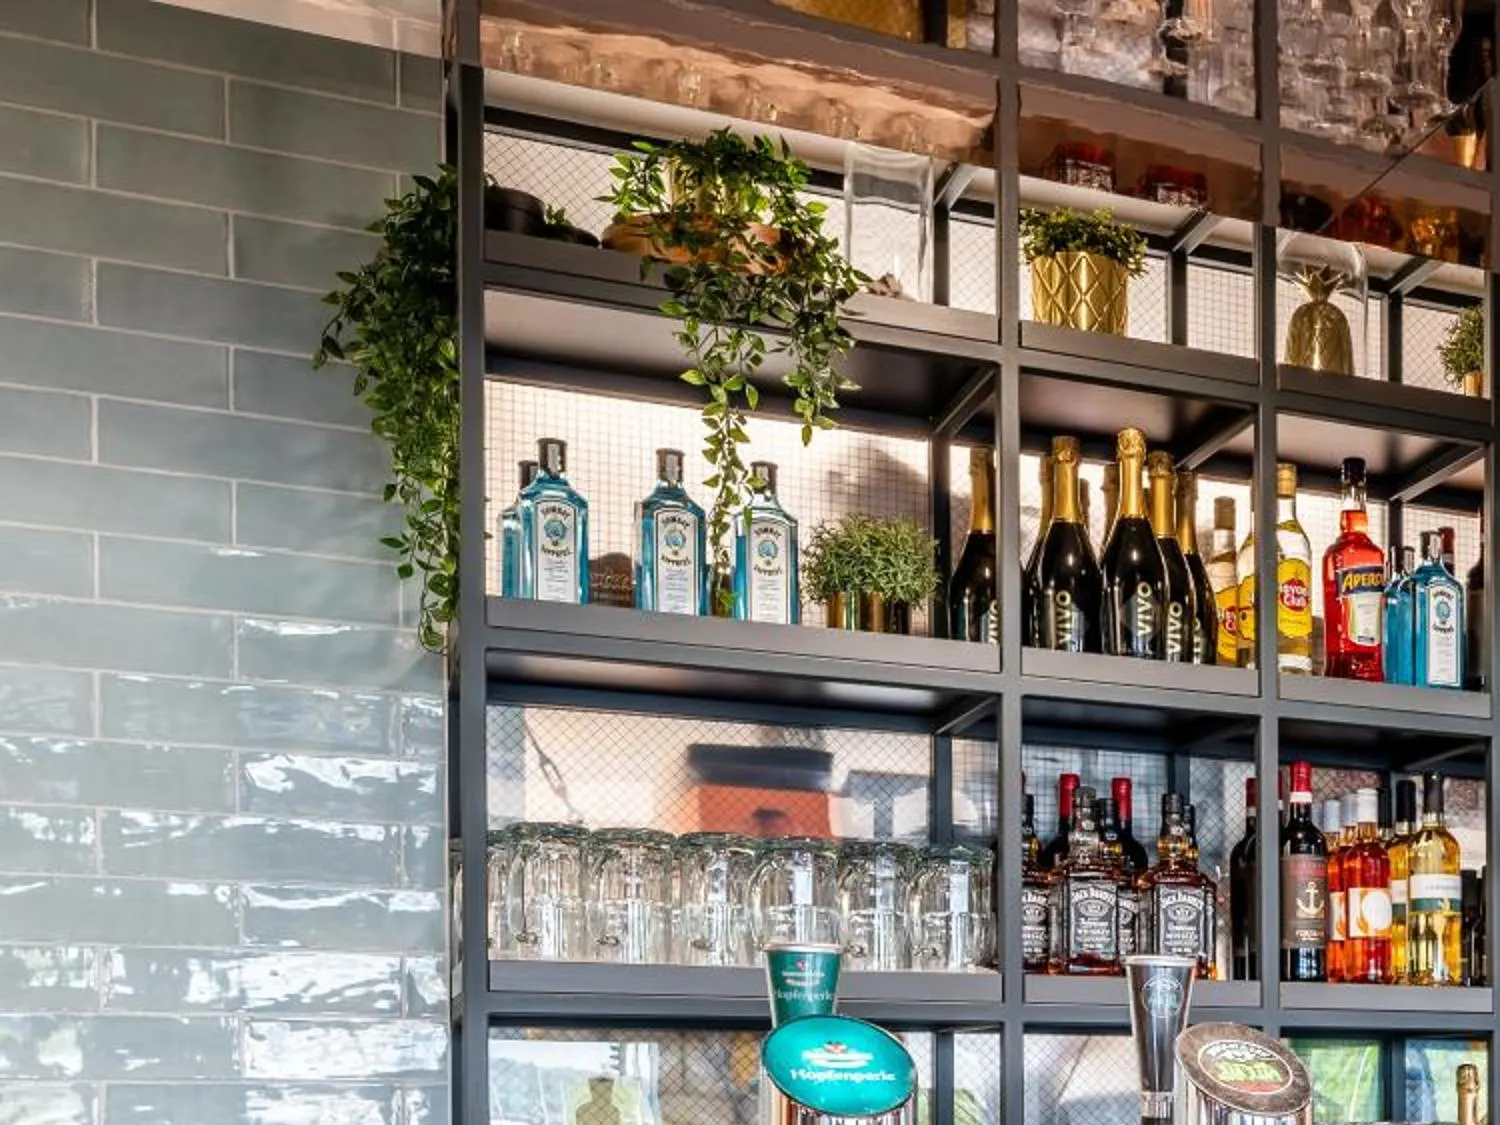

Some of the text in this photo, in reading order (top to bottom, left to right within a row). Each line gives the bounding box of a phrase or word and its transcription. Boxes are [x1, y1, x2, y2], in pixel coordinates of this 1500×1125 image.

[1137, 581, 1153, 637] VIVO
[1342, 572, 1385, 592] APERO
[1056, 590, 1072, 644] VIVO
[1165, 601, 1183, 656] VIVO
